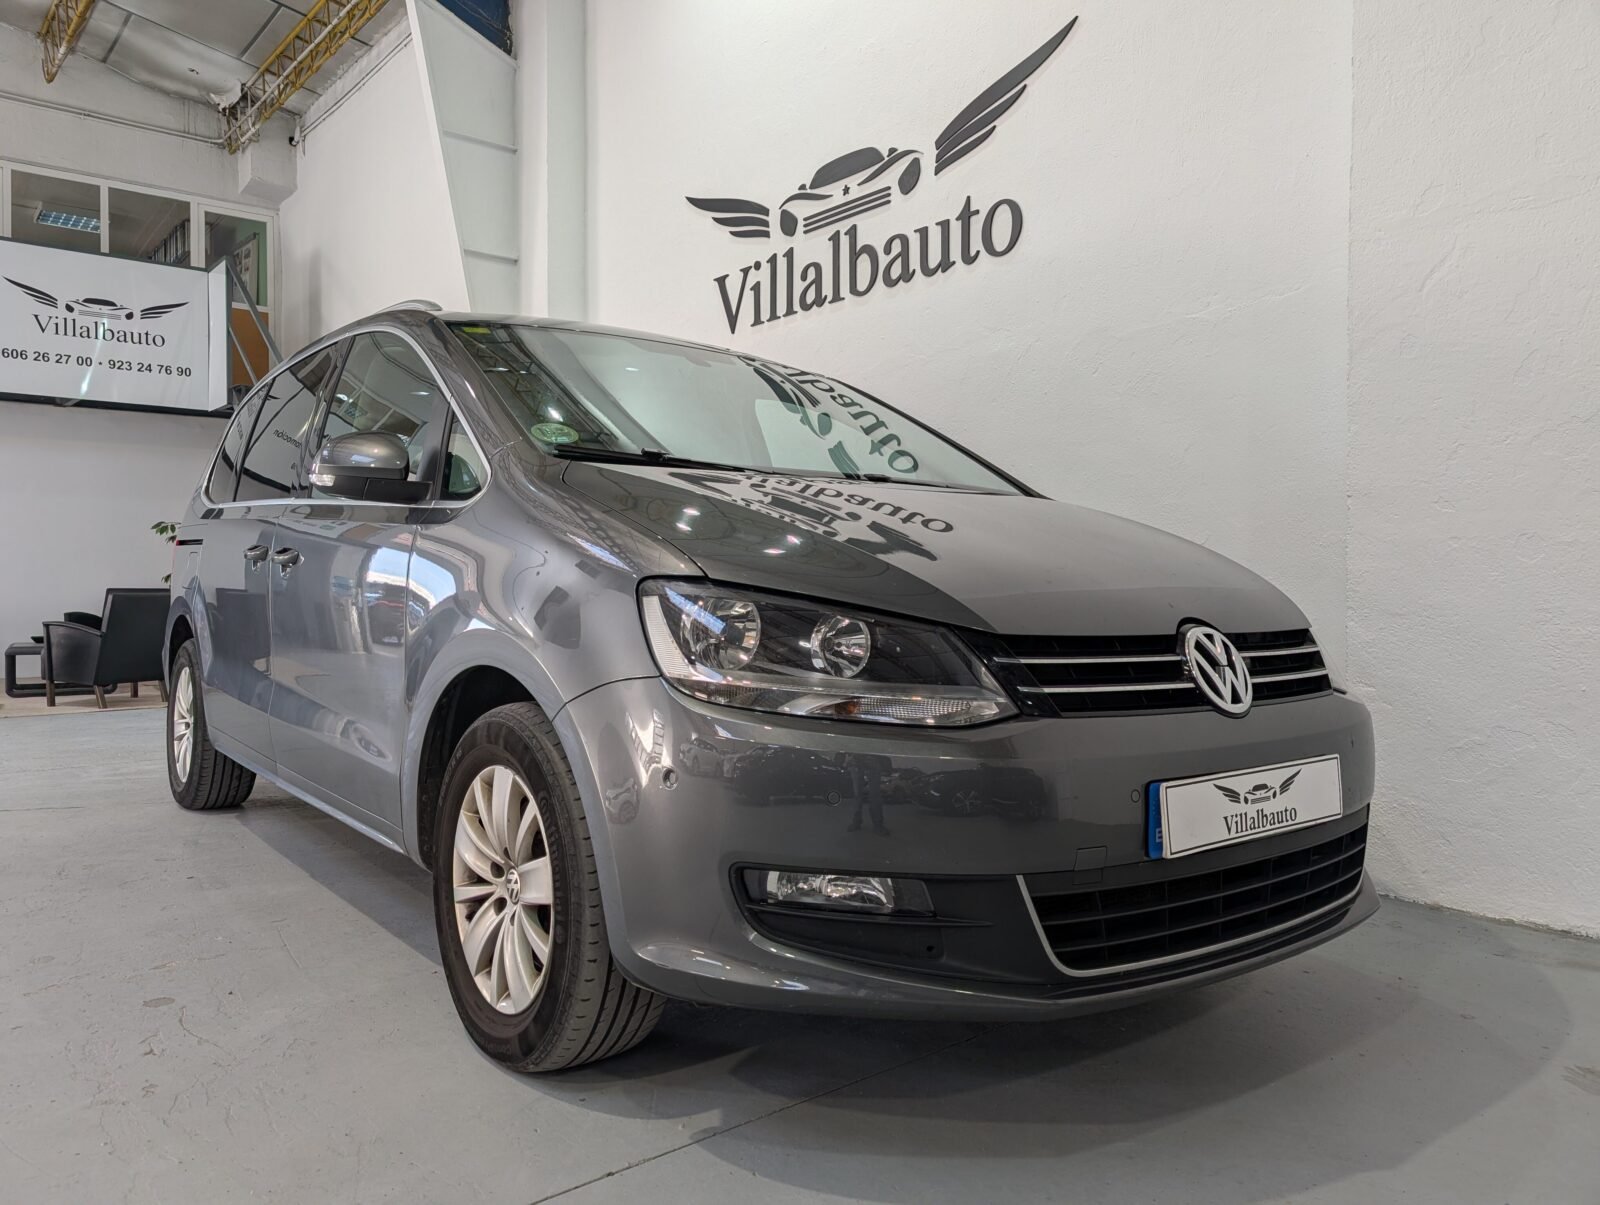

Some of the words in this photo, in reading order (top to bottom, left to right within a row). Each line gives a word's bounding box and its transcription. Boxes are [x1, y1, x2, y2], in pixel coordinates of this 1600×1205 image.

[713, 195, 1023, 334] Villalbauto
[32, 313, 166, 347] Villalbauto
[1, 347, 28, 361] 606
[33, 350, 50, 362] 26
[55, 353, 71, 365] 27
[76, 355, 92, 367] 00
[108, 359, 132, 371] 923
[137, 362, 152, 373] 24
[157, 364, 172, 375] 76
[176, 366, 192, 377] 90
[1223, 806, 1297, 836] Villalbauto
